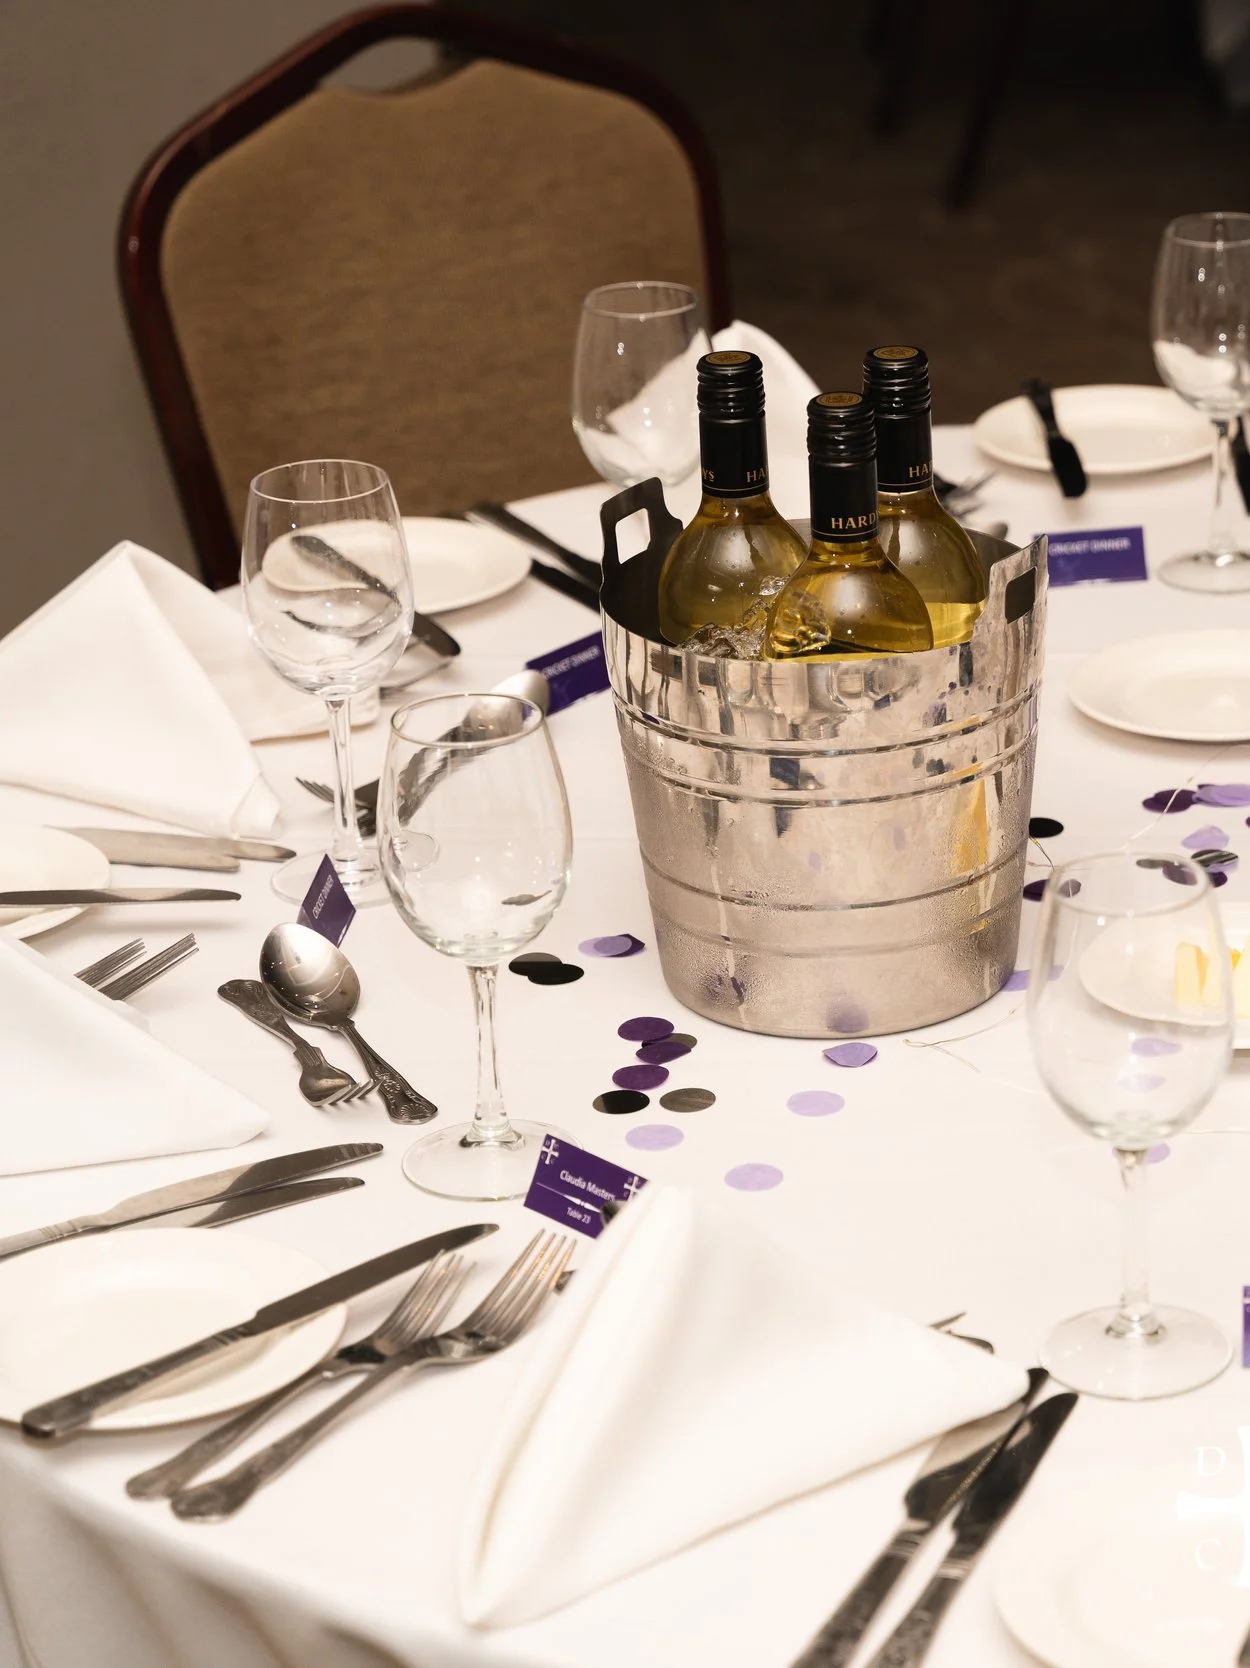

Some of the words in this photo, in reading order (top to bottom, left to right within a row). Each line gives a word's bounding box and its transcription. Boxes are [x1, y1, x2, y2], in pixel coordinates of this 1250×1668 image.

[831, 511, 878, 529] HARD
[559, 1170, 586, 1190] Claudia
[567, 1206, 582, 1221] Table
[581, 1214, 592, 1225] 23
